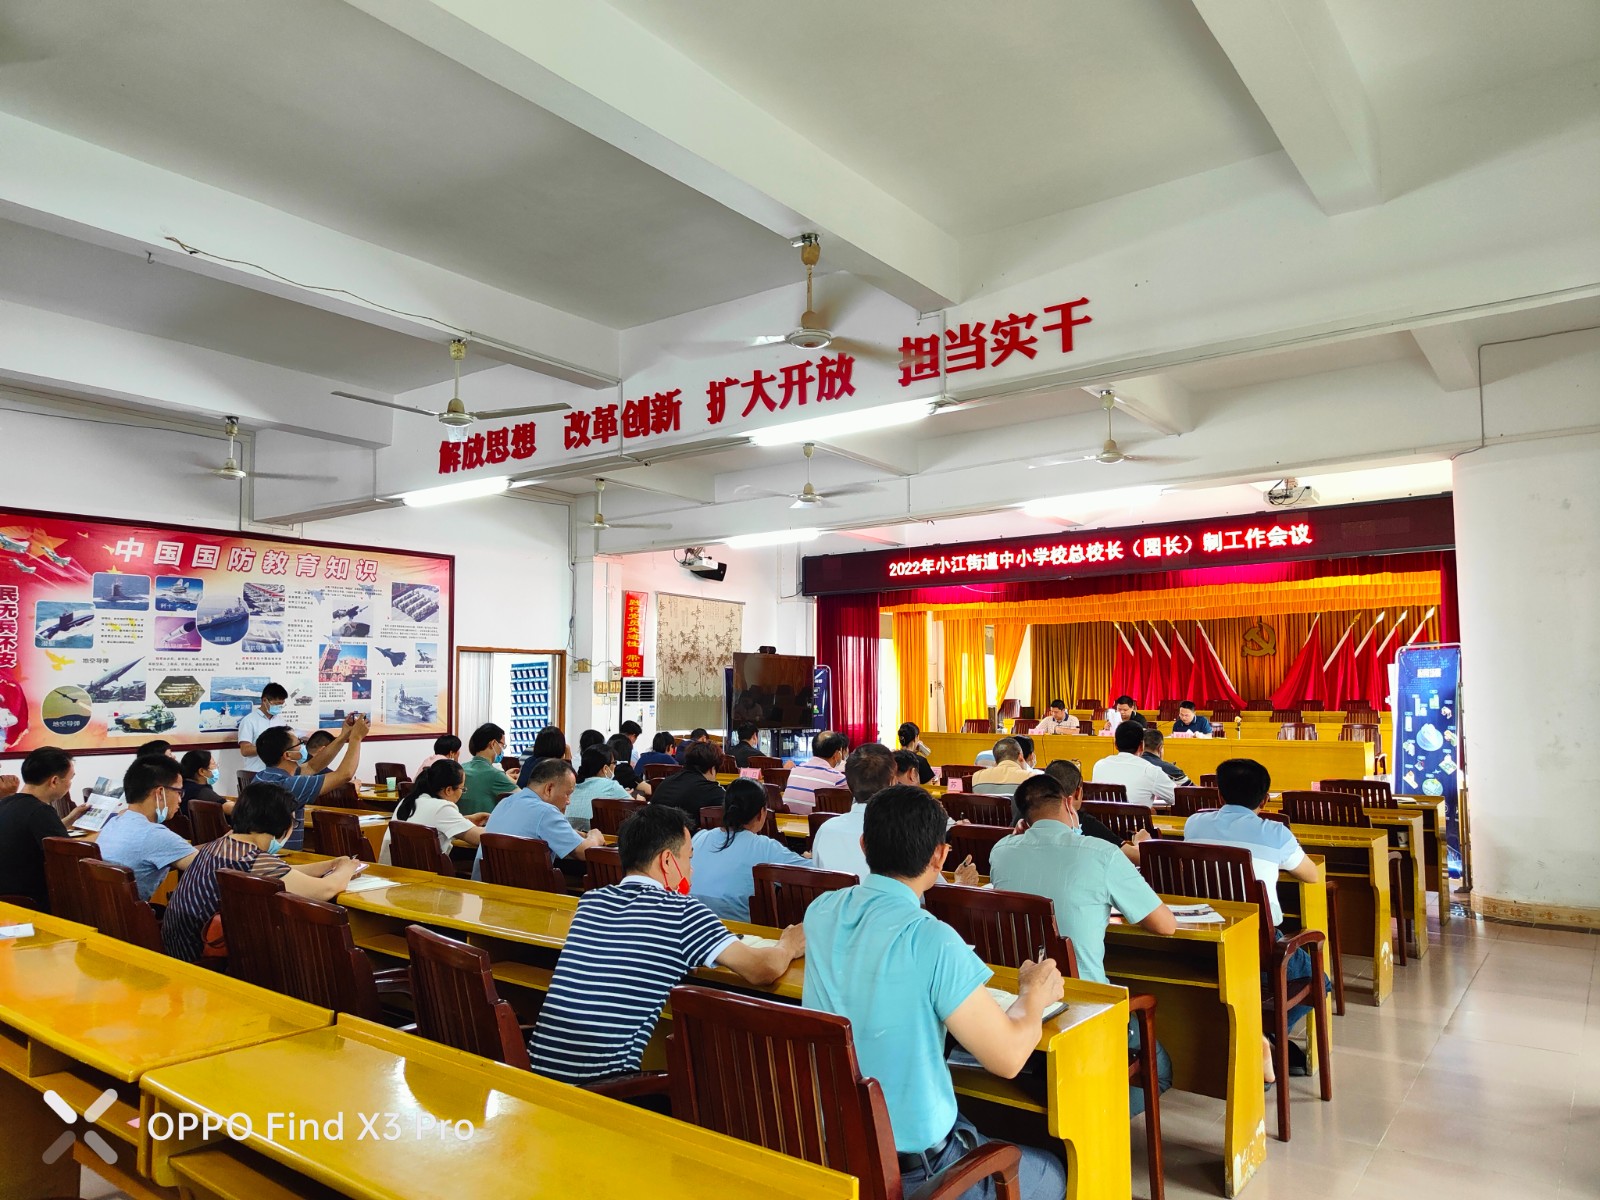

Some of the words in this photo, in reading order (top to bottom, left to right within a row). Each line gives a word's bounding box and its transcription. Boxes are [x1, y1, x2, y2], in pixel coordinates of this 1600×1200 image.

[438, 422, 537, 474] 解放思想
[564, 388, 682, 450] 改革创新
[706, 352, 856, 425] 扩大开放
[898, 297, 1092, 387] 担当实干
[113, 536, 380, 583] 中国国防教育知识
[624, 654, 640, 677] 带领群
[52, 720, 81, 728] 地空导弹
